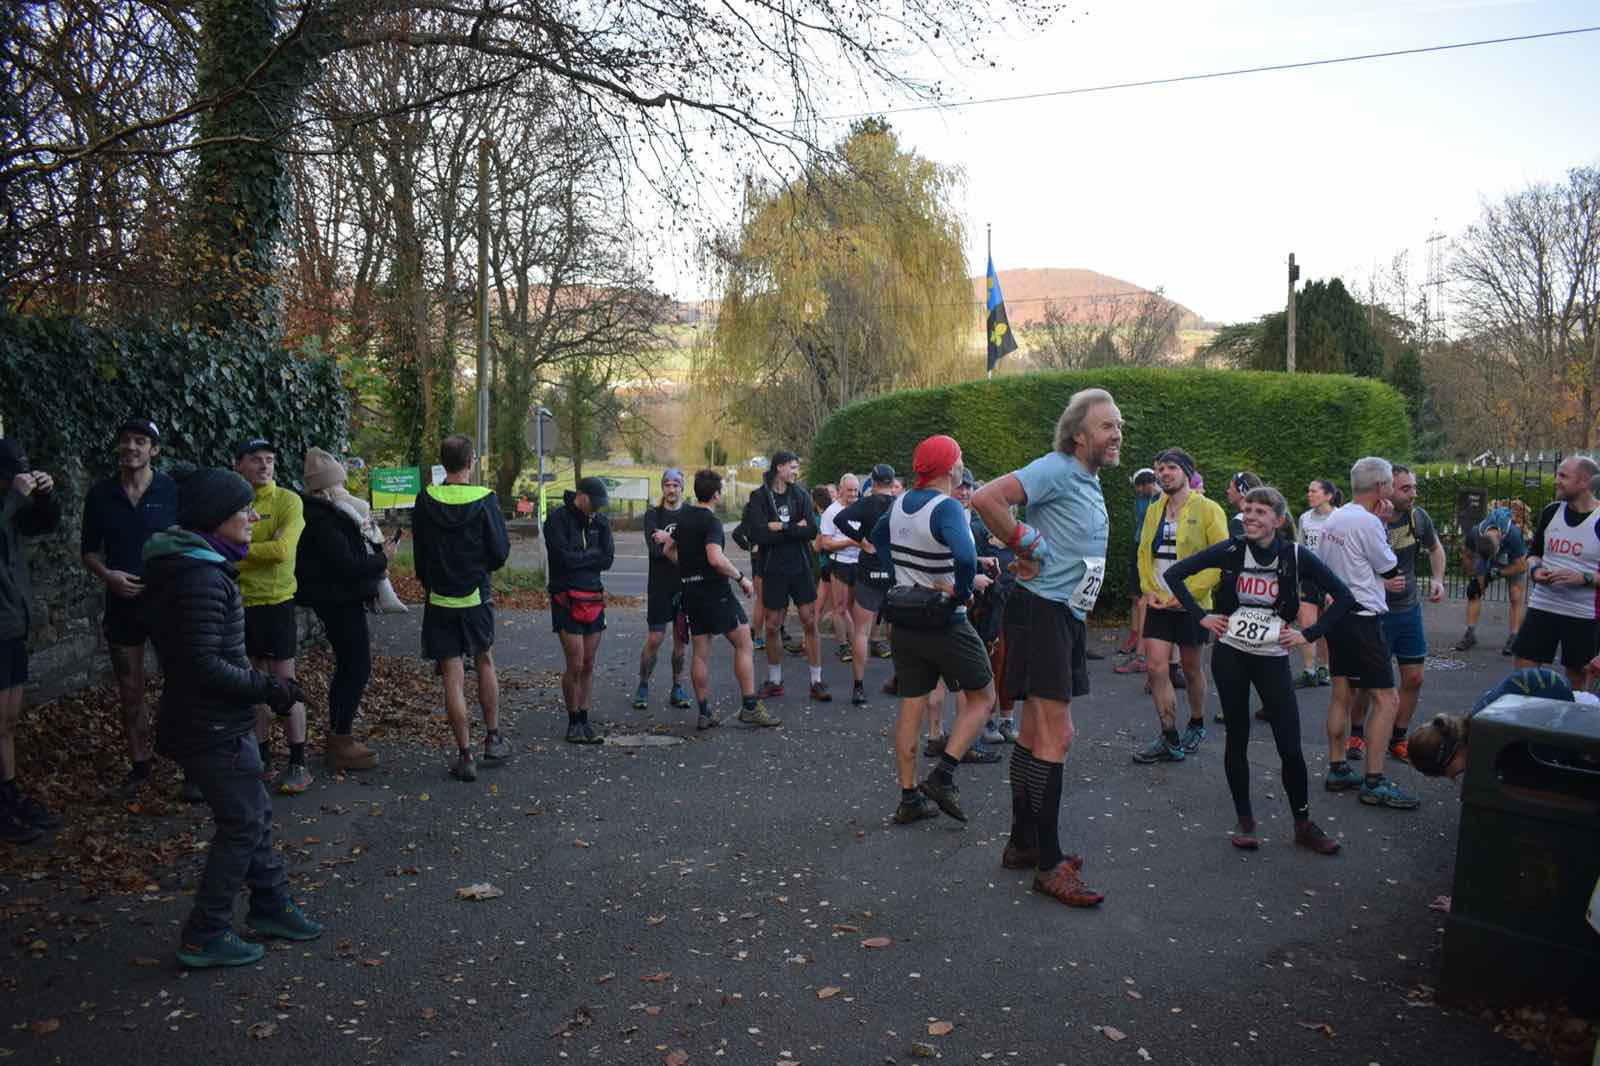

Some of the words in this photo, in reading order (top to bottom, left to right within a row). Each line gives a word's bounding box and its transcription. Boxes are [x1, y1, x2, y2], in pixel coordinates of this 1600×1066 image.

[1548, 537, 1583, 556] MDC
[1240, 610, 1272, 624] ROGUE
[1235, 620, 1269, 640] 287
